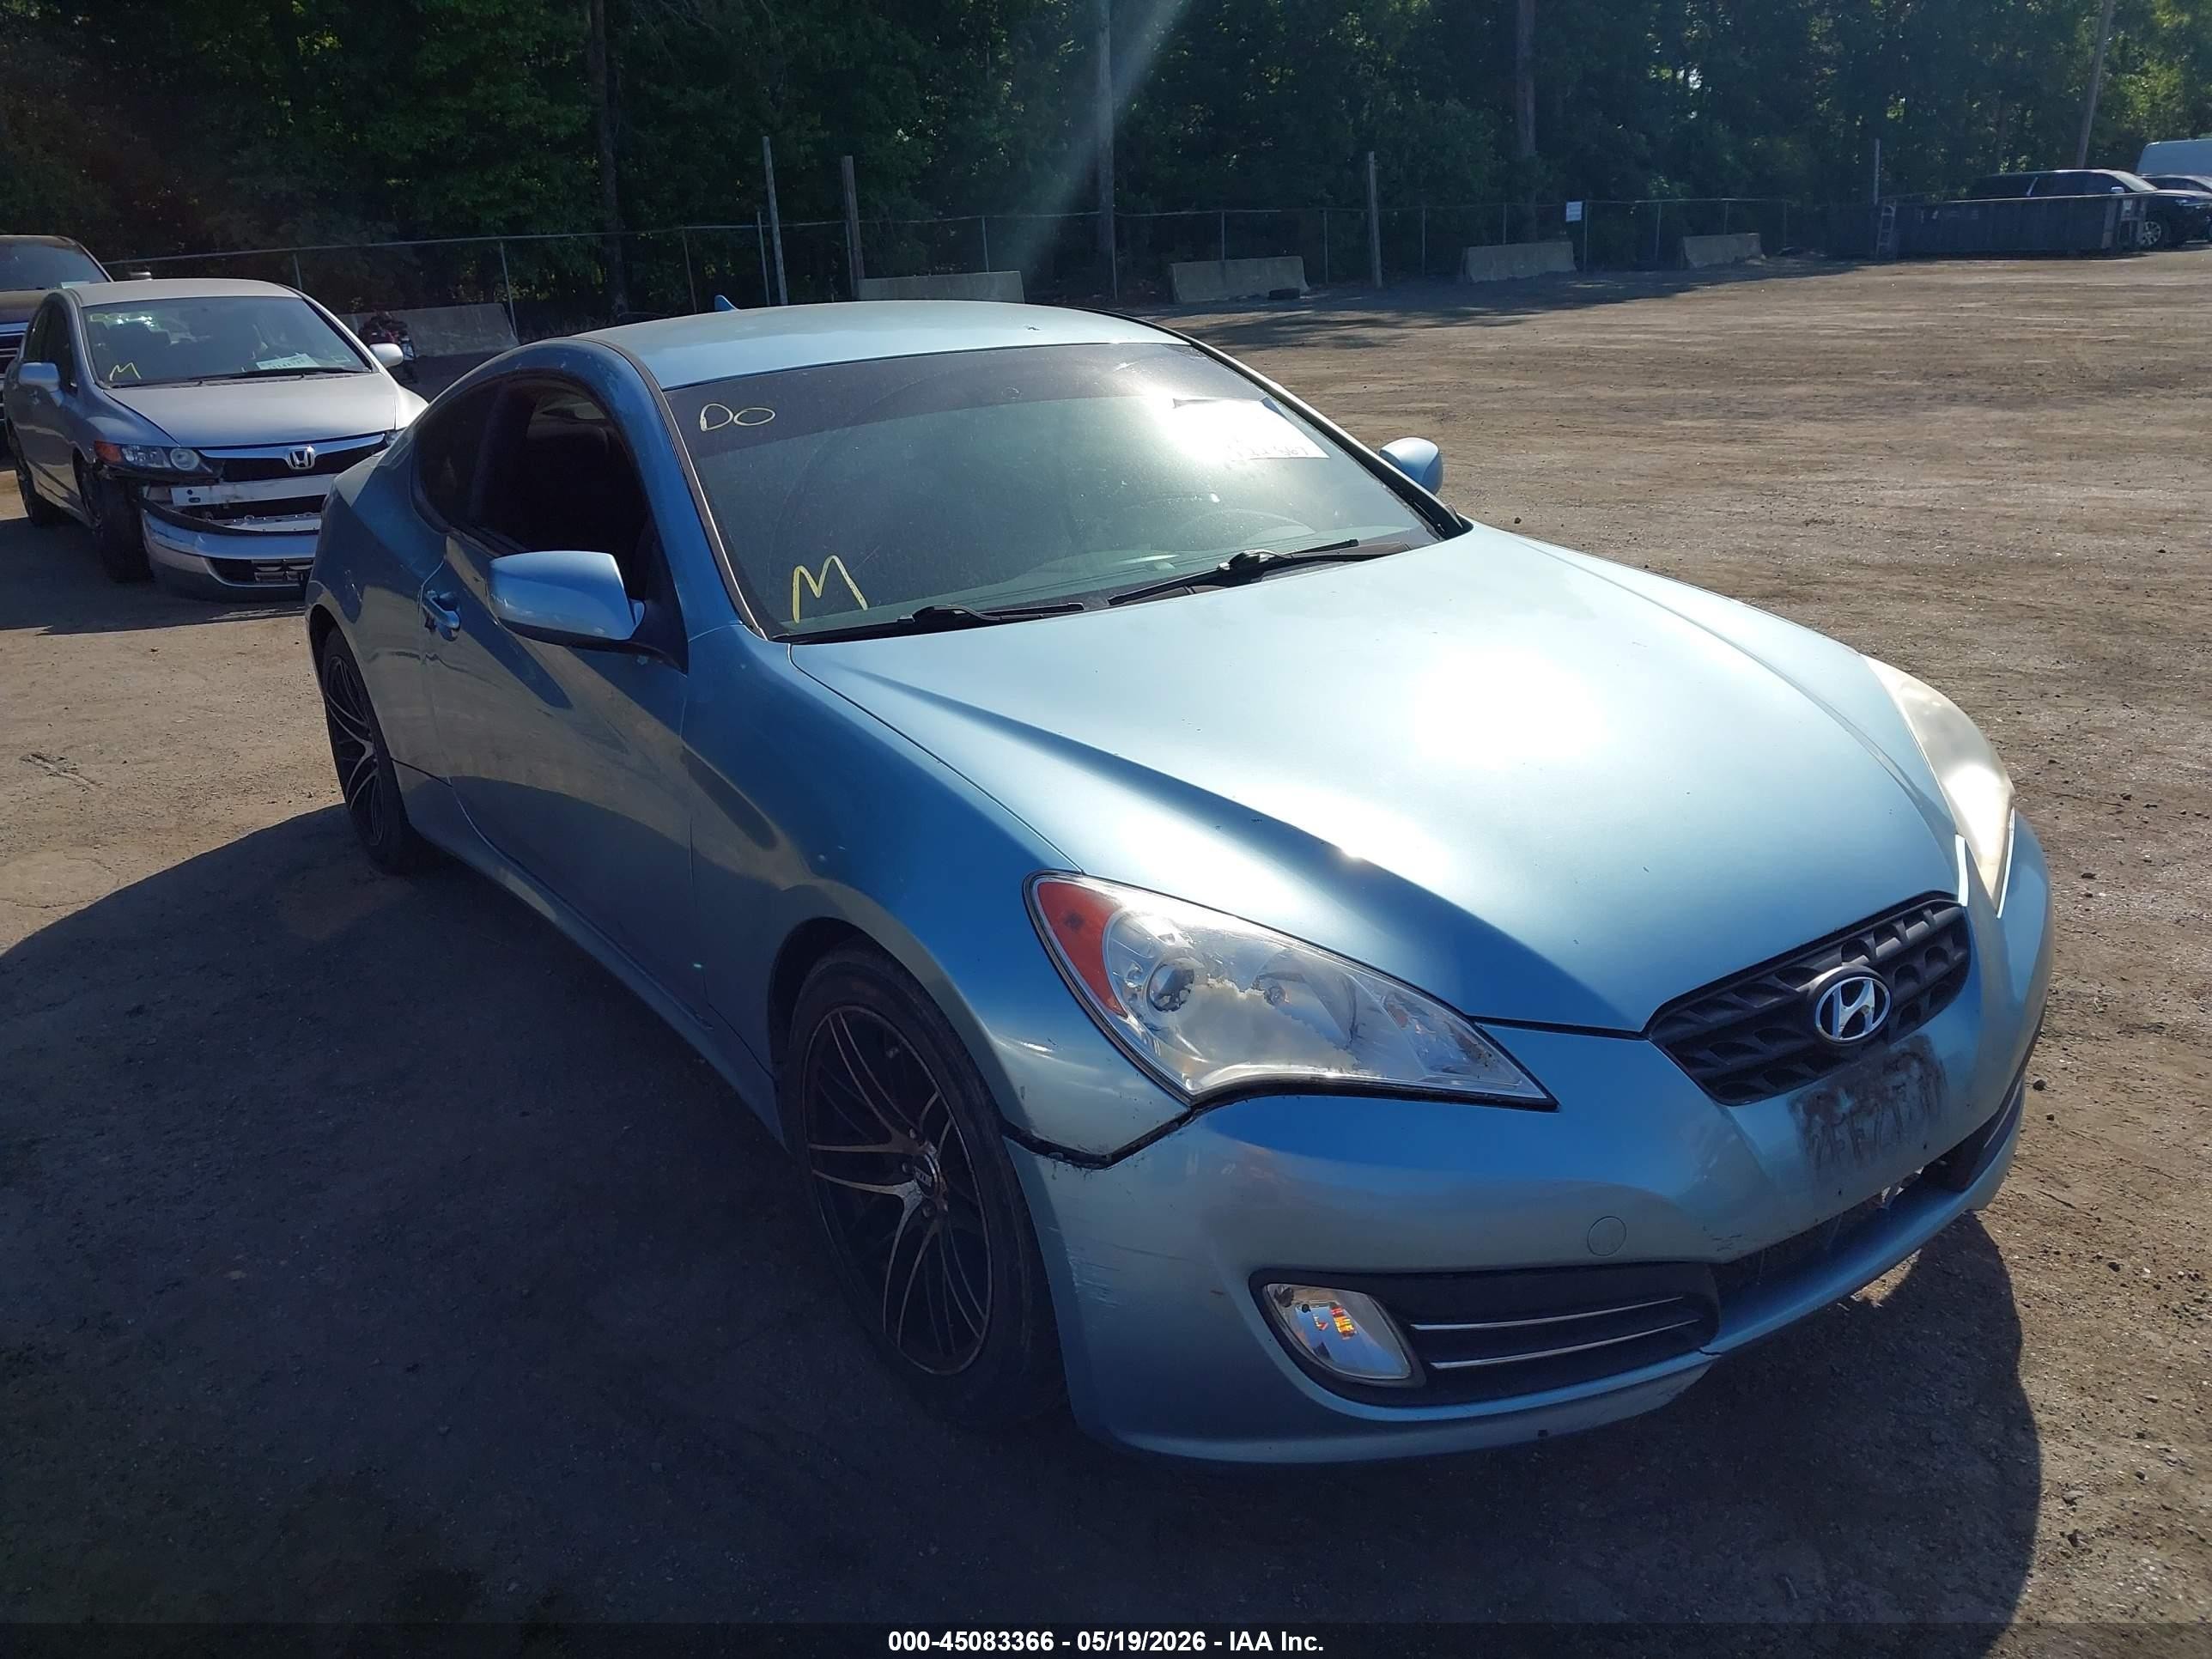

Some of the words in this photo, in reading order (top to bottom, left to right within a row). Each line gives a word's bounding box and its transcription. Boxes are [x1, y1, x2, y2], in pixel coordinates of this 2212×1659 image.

[109, 362, 142, 381] M
[700, 404, 775, 431] DO
[793, 555, 868, 623] M
